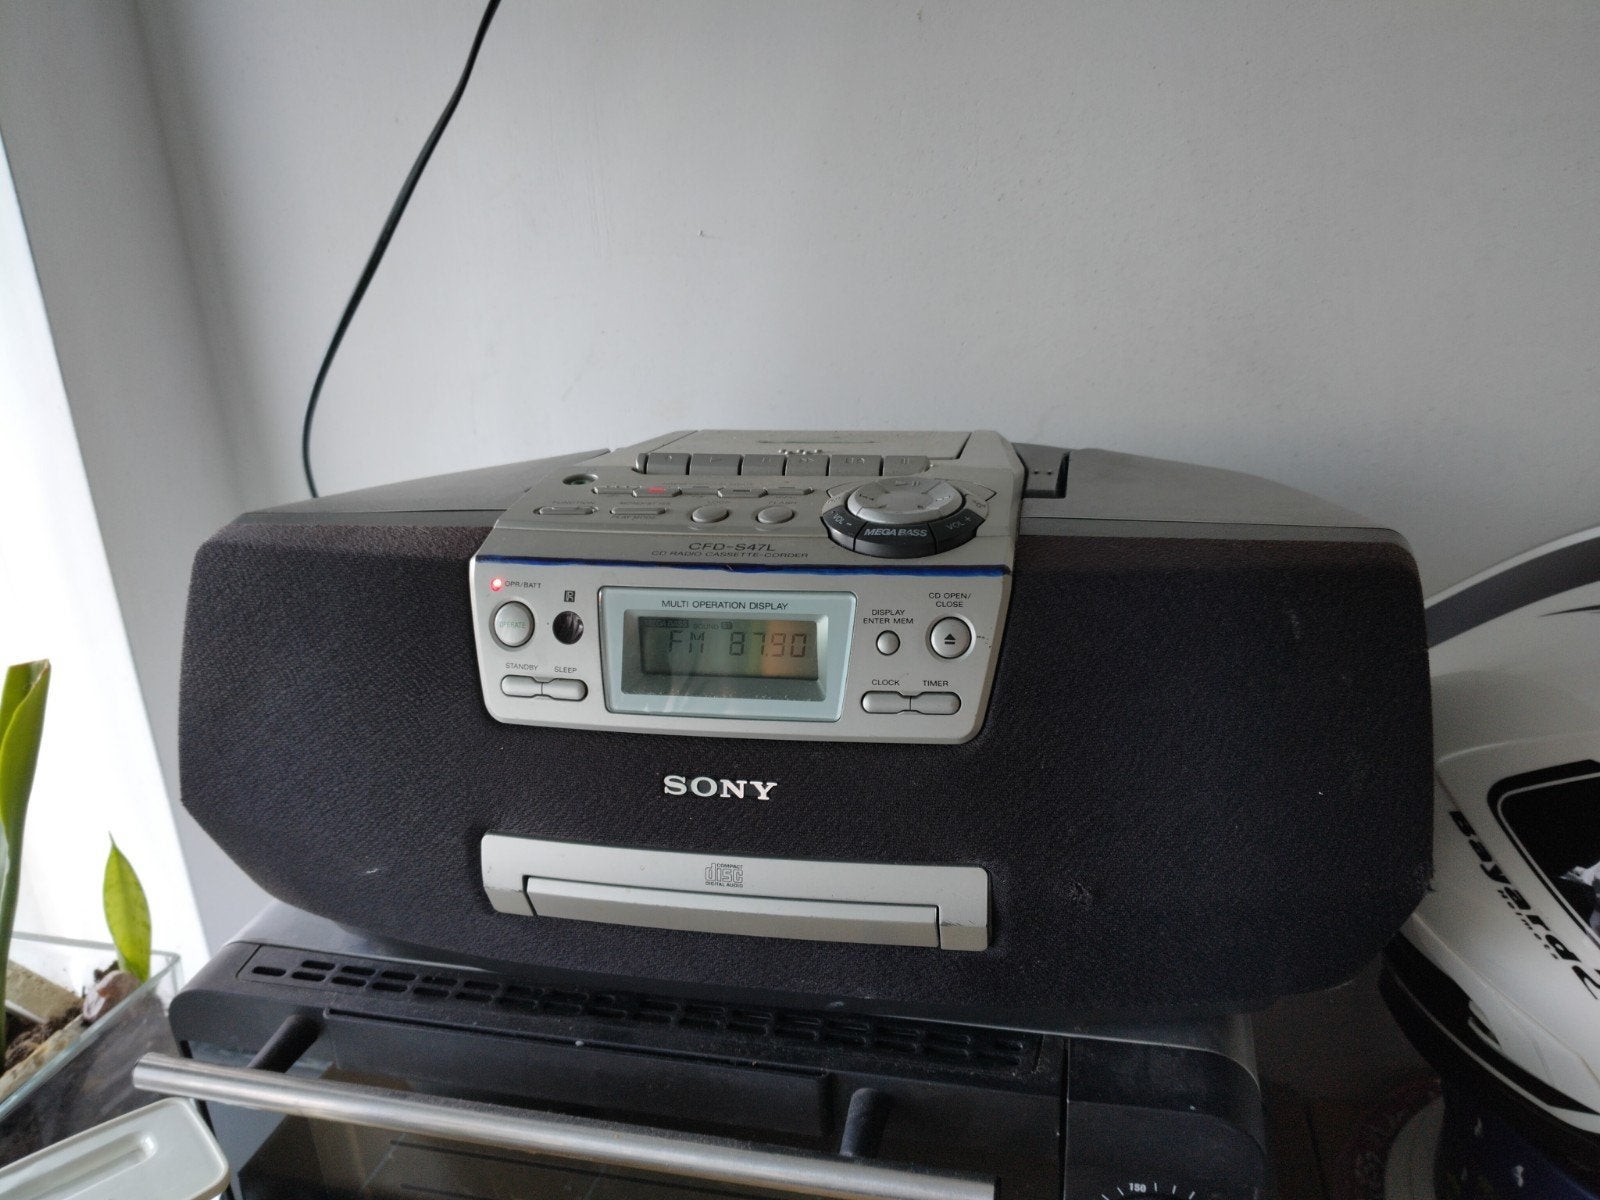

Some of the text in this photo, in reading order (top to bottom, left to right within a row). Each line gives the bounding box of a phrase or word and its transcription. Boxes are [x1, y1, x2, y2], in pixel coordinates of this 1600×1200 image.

[864, 528, 928, 537] MEGA BASS
[688, 542, 776, 552] CFD-S47L
[943, 592, 972, 600] OPEN/
[661, 600, 788, 611] MULTI OPERATION DISPLAY
[935, 600, 964, 608] CLOSE
[863, 617, 891, 625] ENTER
[669, 630, 705, 654] FM
[505, 663, 538, 671] STANDBY
[554, 666, 577, 674] SLEEP
[663, 775, 778, 800] SONY
[705, 863, 743, 884] disc
